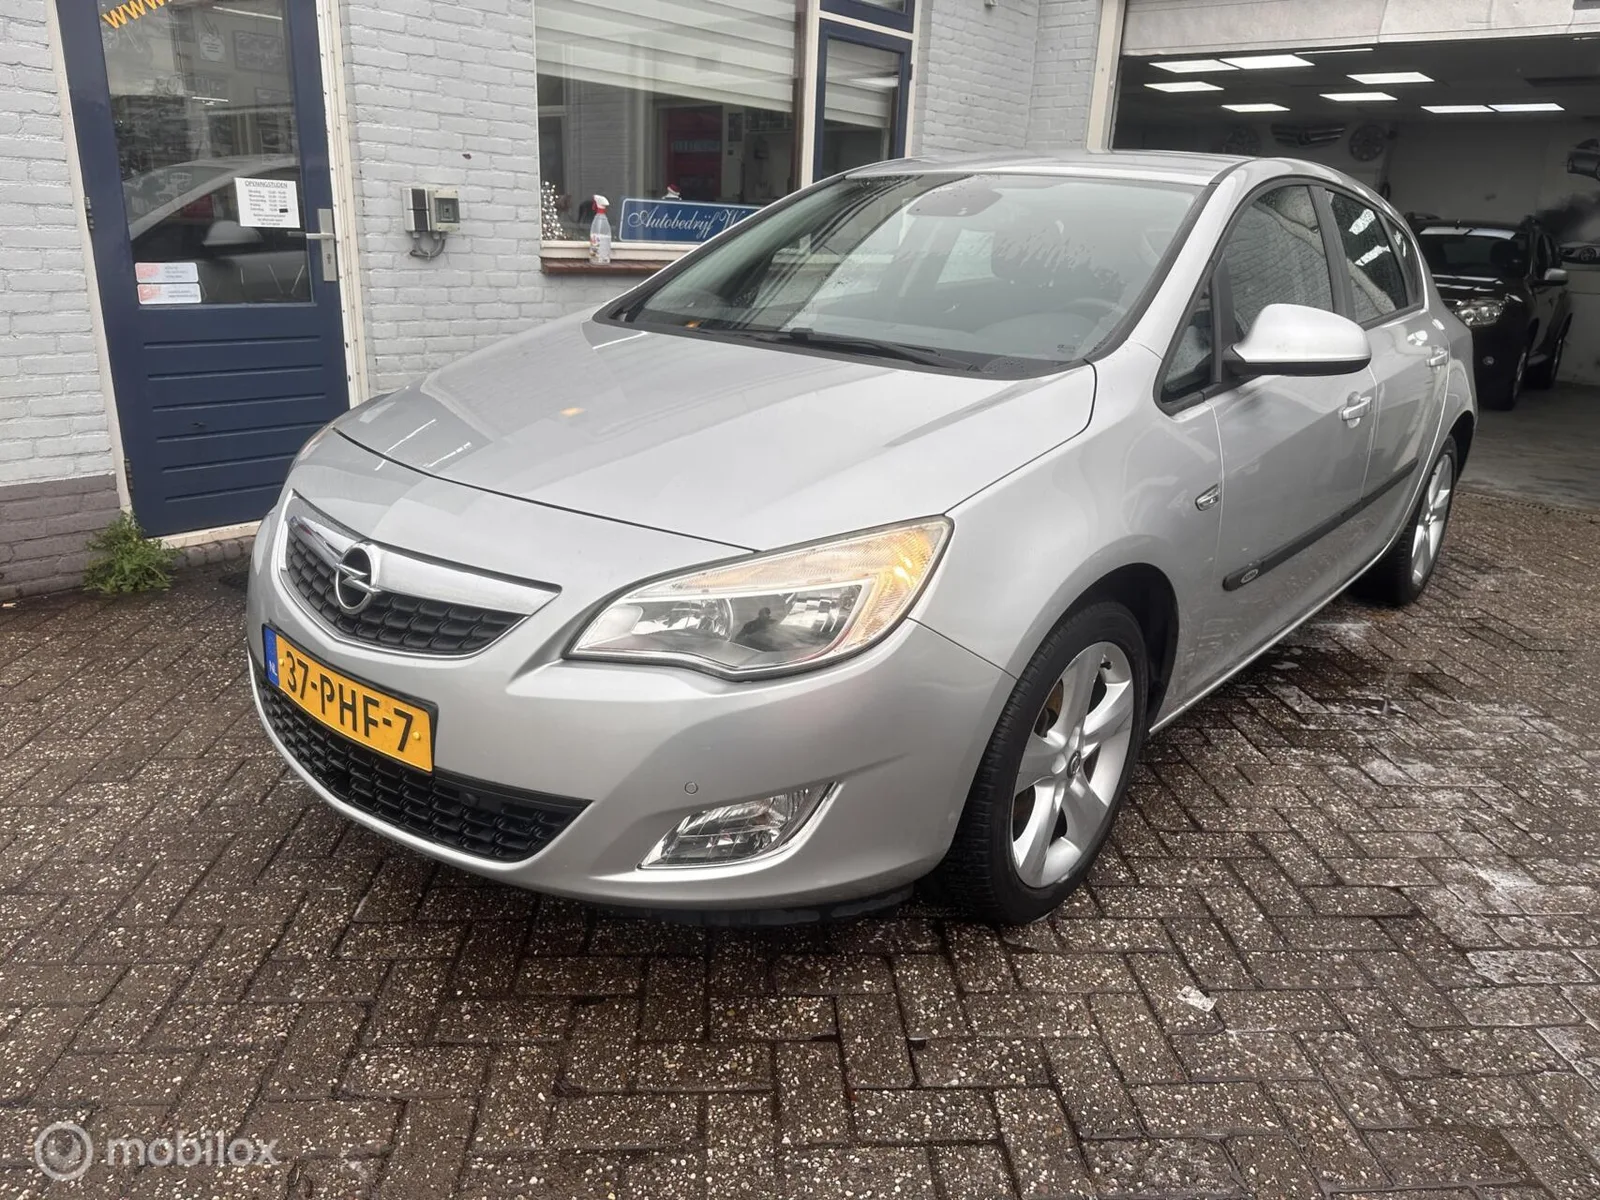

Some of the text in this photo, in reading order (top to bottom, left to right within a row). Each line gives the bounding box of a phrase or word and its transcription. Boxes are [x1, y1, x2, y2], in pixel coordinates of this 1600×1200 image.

[627, 205, 720, 239] Autobedrijf
[268, 660, 278, 677] NL
[285, 650, 414, 752] 37-PHF-7
